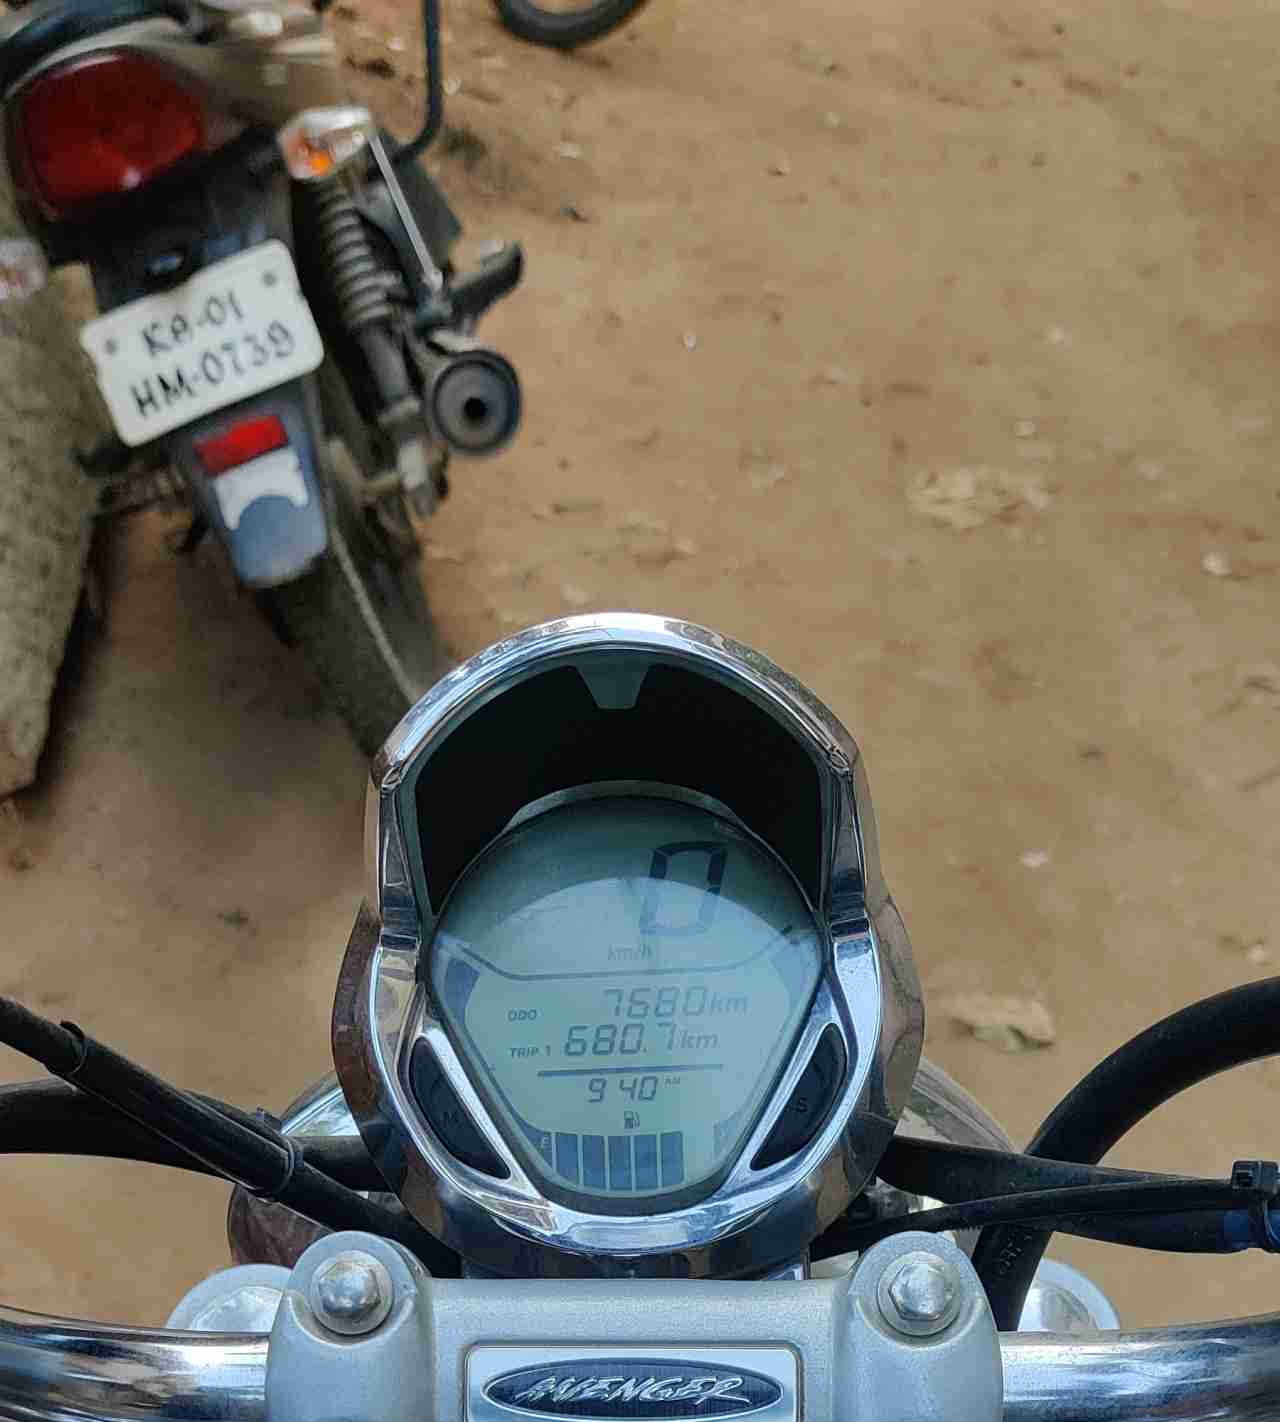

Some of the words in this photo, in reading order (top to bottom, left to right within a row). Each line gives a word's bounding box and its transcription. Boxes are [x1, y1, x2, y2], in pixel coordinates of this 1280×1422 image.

[141, 289, 244, 358] KA-01
[130, 321, 296, 417] HM-0739
[638, 840, 728, 937] 0
[507, 1008, 537, 1022] ODO
[509, 1046, 538, 1059] TRIP
[513, 1376, 751, 1405] AVENGER
